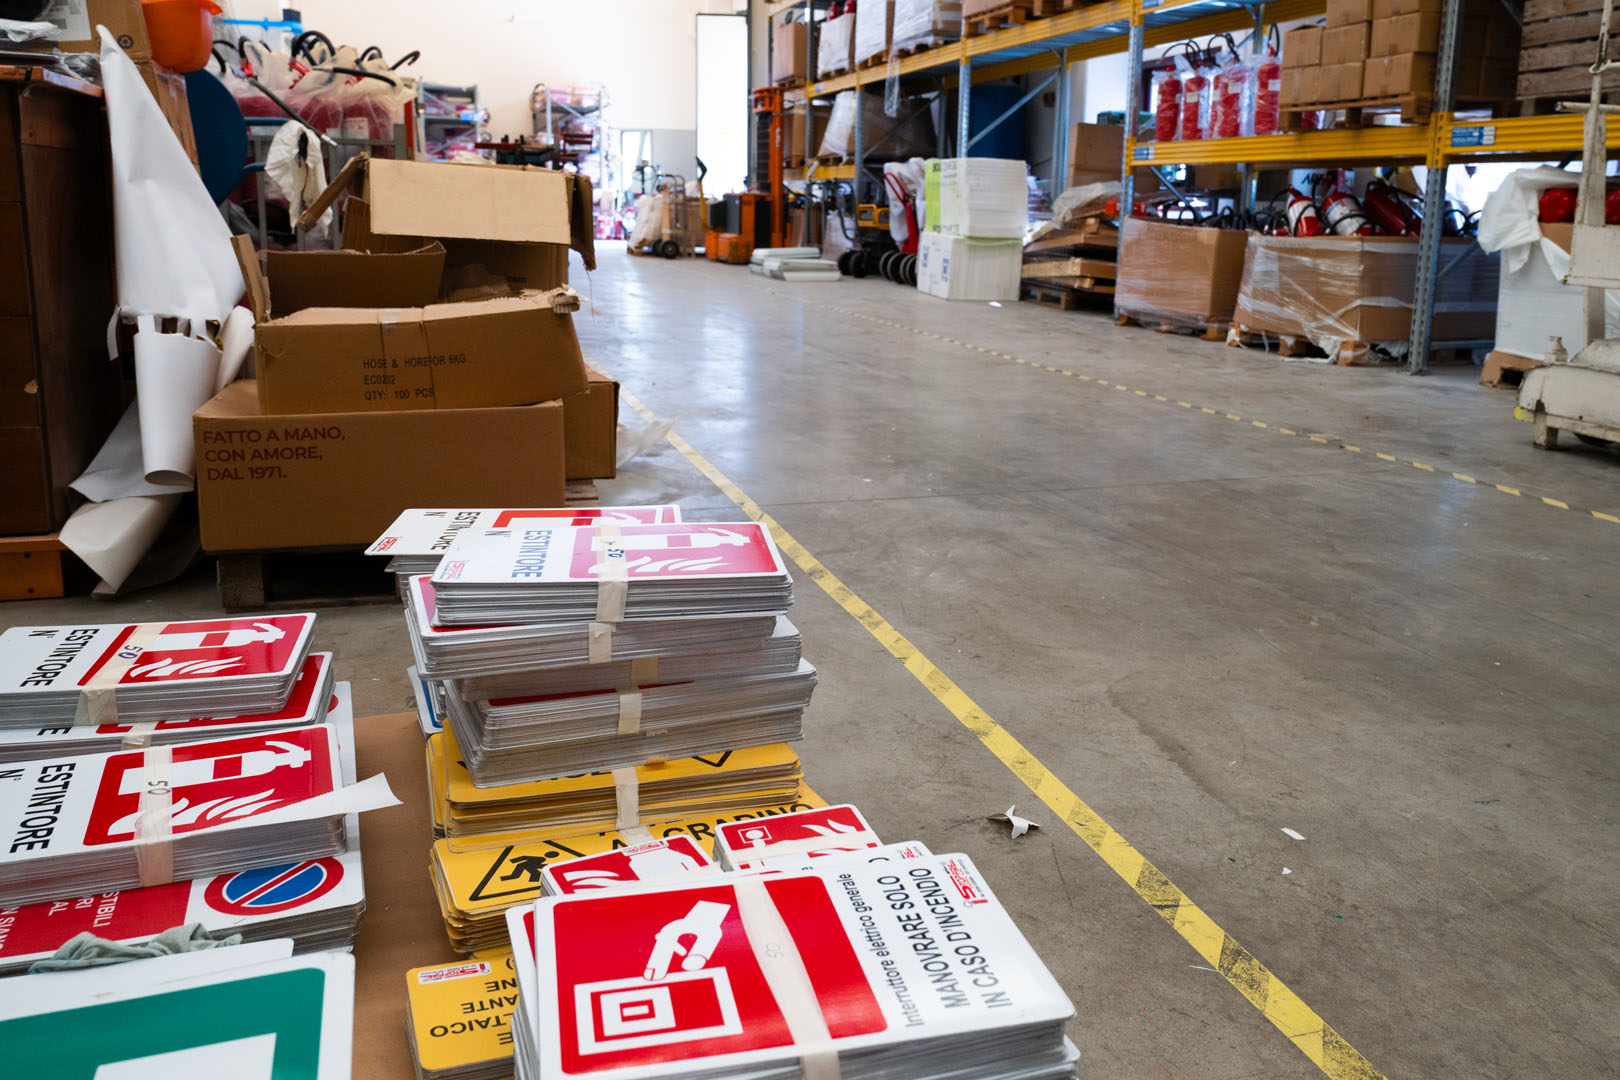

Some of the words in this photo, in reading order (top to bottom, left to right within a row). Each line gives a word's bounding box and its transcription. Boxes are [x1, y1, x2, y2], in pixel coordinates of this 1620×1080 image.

[363, 358, 387, 369] HOSE
[391, 359, 398, 368] &
[394, 389, 410, 400] 100
[415, 387, 434, 399] PCS
[203, 429, 262, 444] FATTO
[266, 429, 280, 442] A
[284, 426, 346, 441] MANO,
[204, 448, 246, 462] CON
[250, 446, 324, 461] AMORE,
[207, 467, 245, 480] DAL
[511, 529, 553, 578] ESTINTORE
[20, 628, 100, 687] ESTINTORE
[117, 644, 144, 660] 50
[147, 780, 171, 796] 50
[9, 762, 77, 854] ESTINTORE
[836, 873, 873, 913] generale
[876, 875, 916, 911] SOLO
[908, 868, 973, 942] D'INCENDIO
[859, 915, 891, 957] elettrico
[896, 913, 971, 1009] MANOVRARE
[954, 945, 999, 987] CASO
[880, 959, 926, 1028] Interruttore
[981, 991, 1013, 1009] IN
